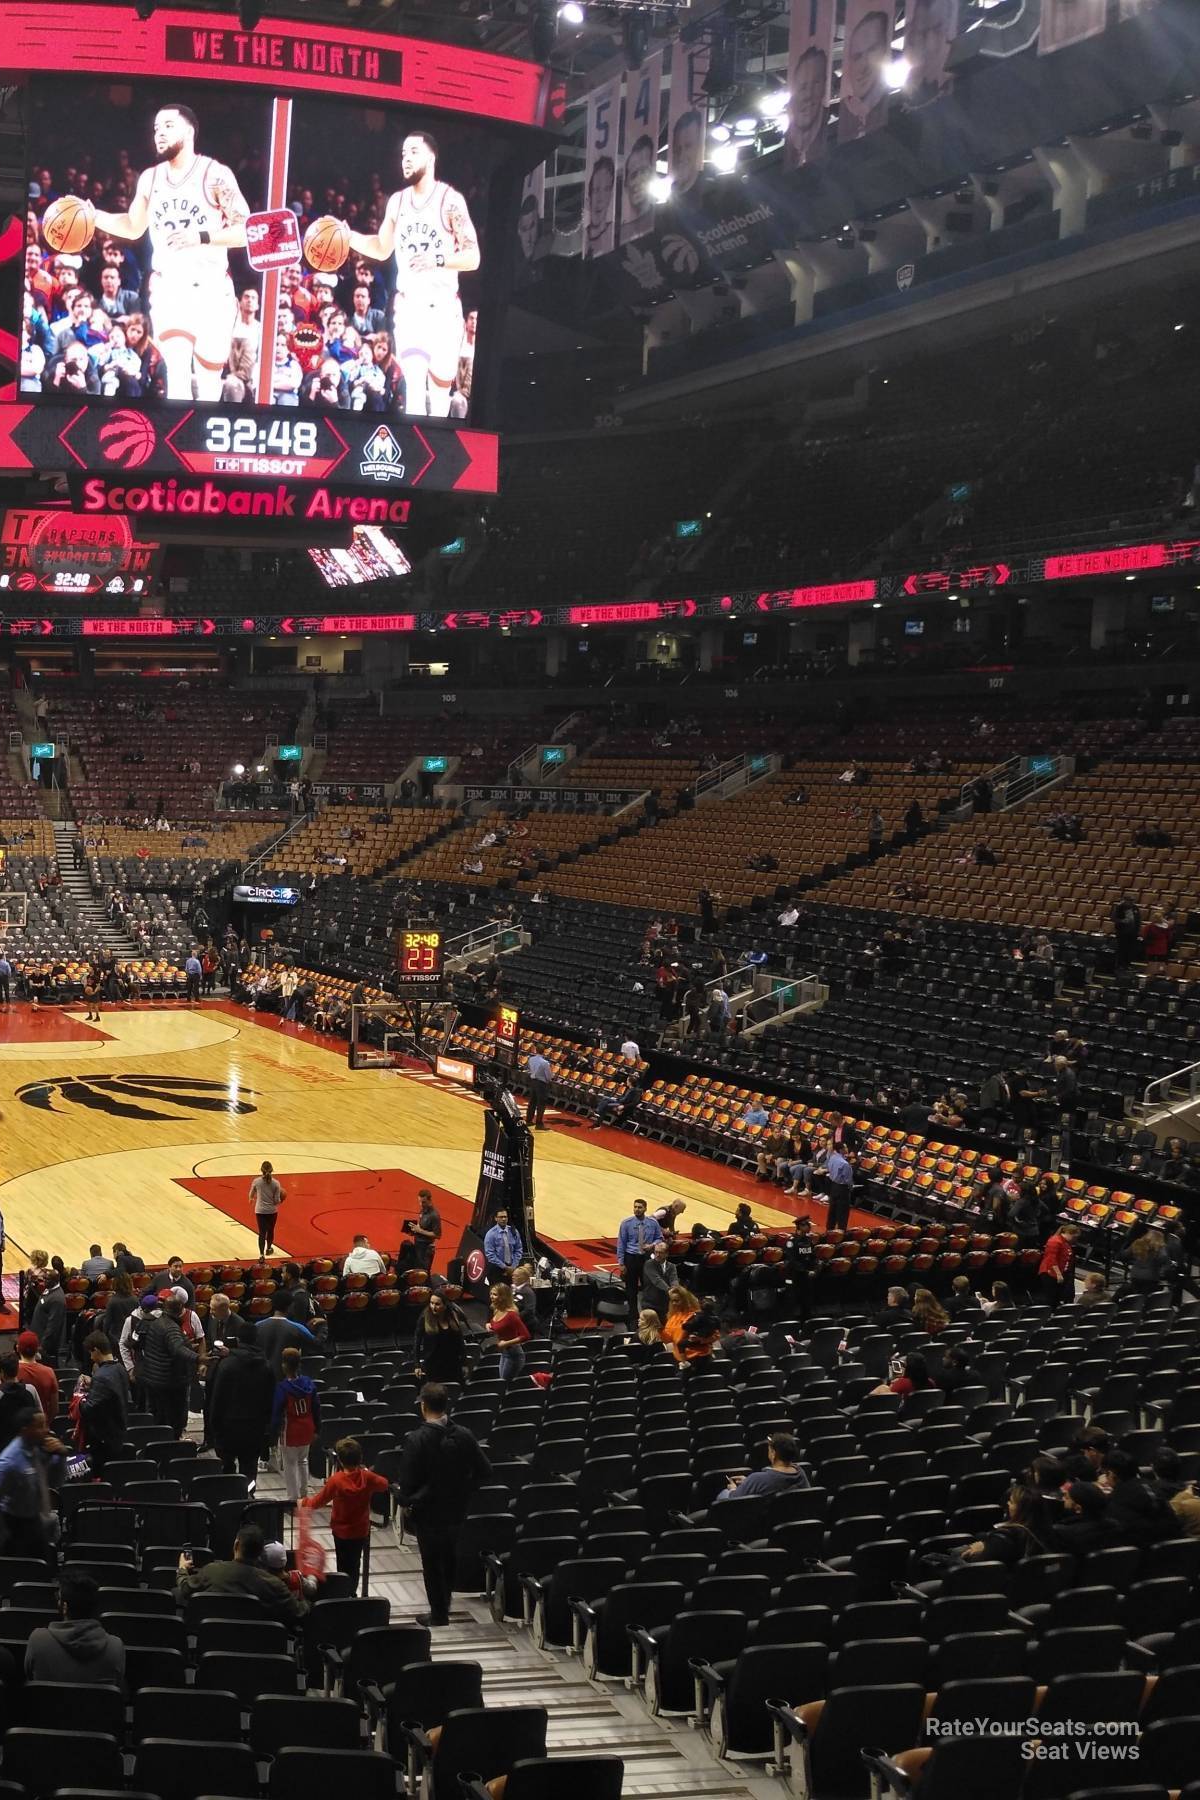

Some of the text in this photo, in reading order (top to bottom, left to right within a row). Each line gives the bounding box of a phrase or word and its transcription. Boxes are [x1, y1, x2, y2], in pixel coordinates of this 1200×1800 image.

[192, 31, 379, 80] WE THE NORTH
[635, 78, 649, 122] 4
[595, 102, 611, 148] 5
[696, 203, 775, 245] Scotiabank
[278, 241, 298, 252] THE
[705, 233, 749, 258] Arena
[205, 416, 318, 458] 32:48
[240, 458, 307, 475] TISSOT
[82, 479, 413, 523] Scotiabank Arena
[50, 529, 116, 542] RAPTORS
[1059, 554, 1150, 575] WE THE NORTH
[54, 572, 91, 587] 32:48
[580, 606, 650, 621] WE THE NORTH
[92, 621, 164, 633] WE THE NORTH
[334, 615, 405, 630] WE THE NORTH
[988, 677, 1004, 688] 107
[441, 694, 457, 704] 105
[724, 689, 739, 699] 106
[312, 786, 330, 795] IBM
[363, 786, 381, 796] IBM
[467, 790, 484, 800] IBM
[491, 790, 507, 800] IBM
[515, 791, 531, 801] IBM
[540, 791, 557, 801] IBM
[584, 792, 600, 802] IBM
[405, 933, 440, 948] 32:48
[407, 948, 434, 970] 23
[412, 974, 441, 982] TISSOT
[502, 1021, 514, 1036] 23
[483, 1163, 505, 1180] MILK
[294, 1399, 307, 1417] 10
